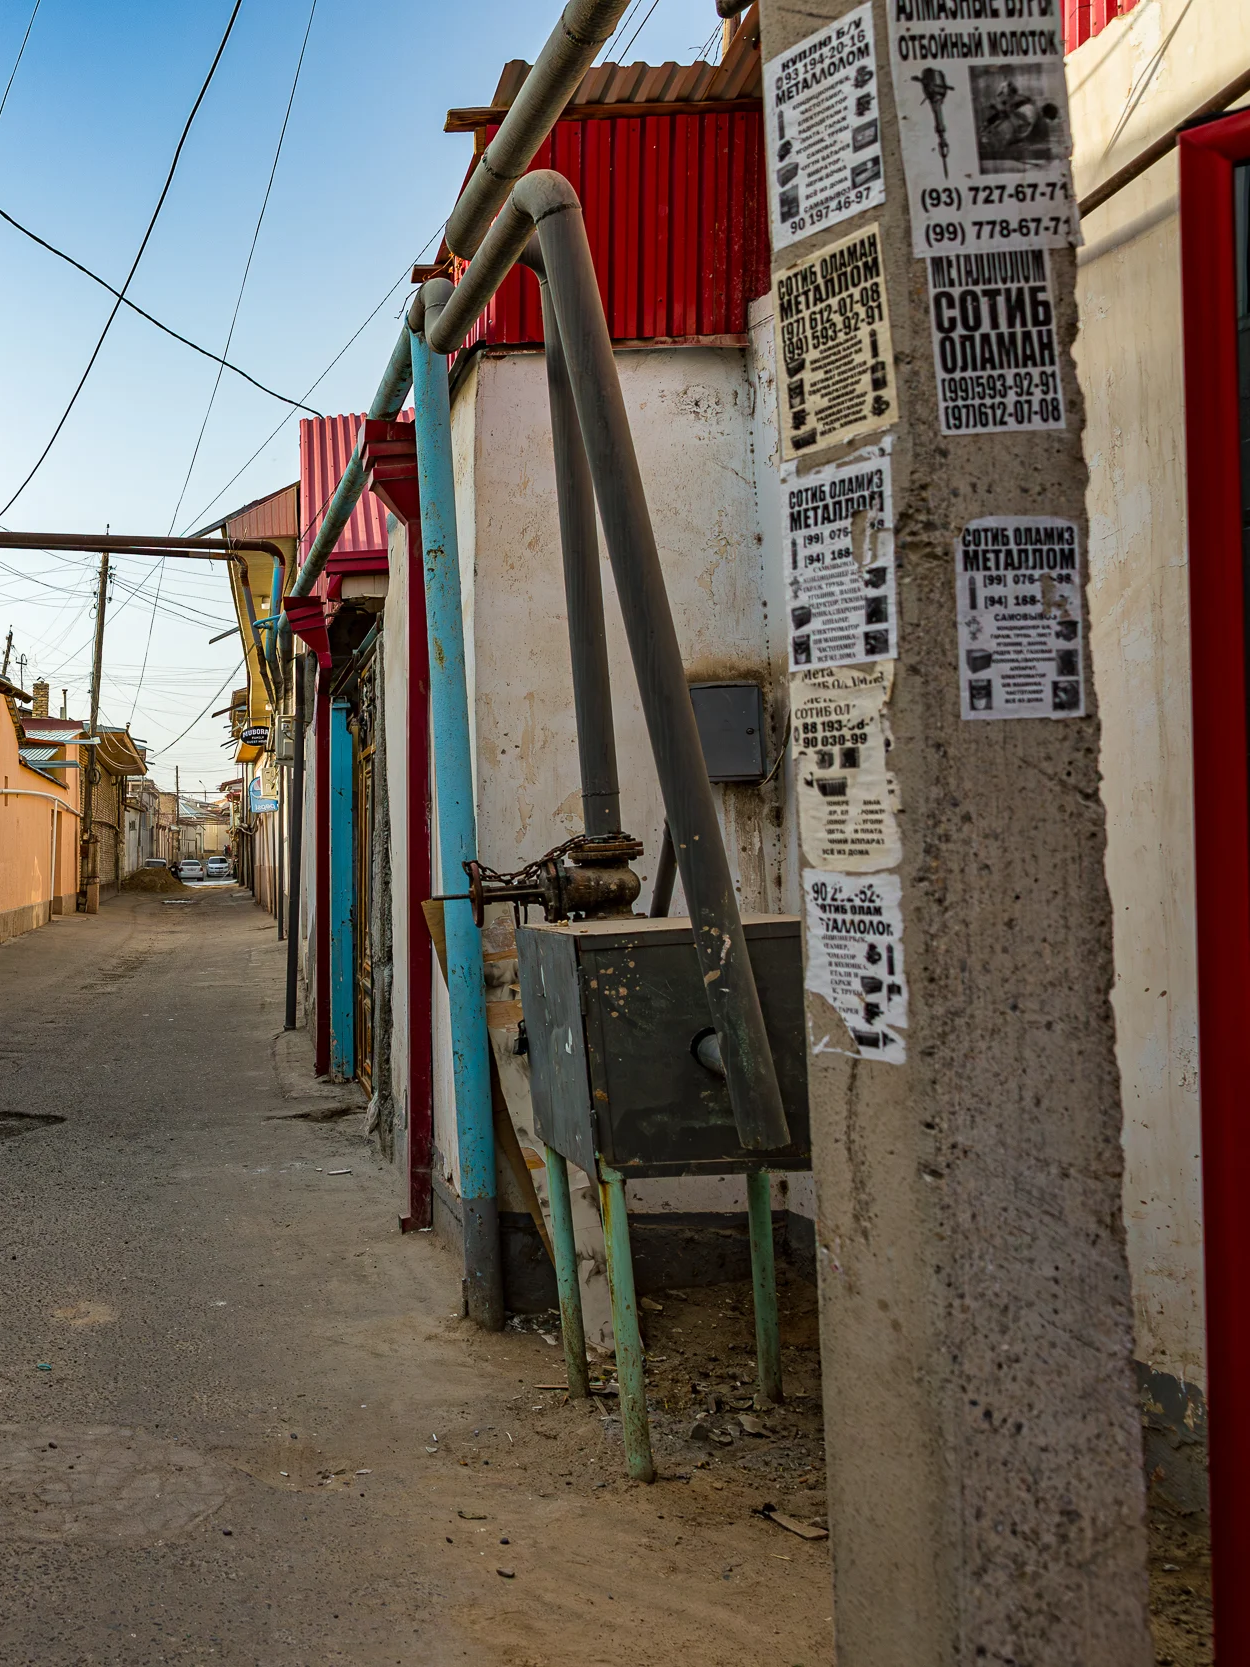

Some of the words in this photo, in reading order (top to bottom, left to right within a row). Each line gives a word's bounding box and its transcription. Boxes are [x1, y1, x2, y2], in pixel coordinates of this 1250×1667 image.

[781, 35, 832, 73] КУПЛЮ
[802, 29, 866, 75] 194-20-16
[898, 27, 984, 61] ОТБОЙНЫЙ
[988, 29, 1059, 58] МОЛОТОК
[775, 42, 870, 108] МЕТАЛЛОЛОМ
[790, 217, 806, 235] 90
[808, 186, 871, 226] 197-46-97
[921, 187, 962, 213] (93)
[968, 181, 1069, 205] 727-67-71
[925, 222, 966, 248] (99)
[972, 216, 1072, 240] 778-67-71
[777, 263, 817, 301] СОТИБ
[820, 233, 877, 280] ОЛАМАН
[779, 255, 880, 323] МЕТАЛЛОМ
[808, 281, 880, 331] 612-07-08
[811, 301, 883, 349] 593-92-91
[933, 285, 1052, 335] СОТИБ
[939, 328, 1056, 374] ОЛАМАН
[788, 483, 826, 510] СОТИБ
[829, 468, 883, 500] ОЛАМИЗ
[962, 528, 1010, 548] СОТИБ
[1013, 526, 1075, 547] ОЛАМИЗ
[962, 547, 1076, 572] МЕТАЛЛОМ
[794, 705, 831, 720] СОТИБ
[802, 721, 817, 735] 88
[803, 736, 817, 748] 90
[821, 732, 867, 747] 030-99
[812, 882, 827, 902] 90
